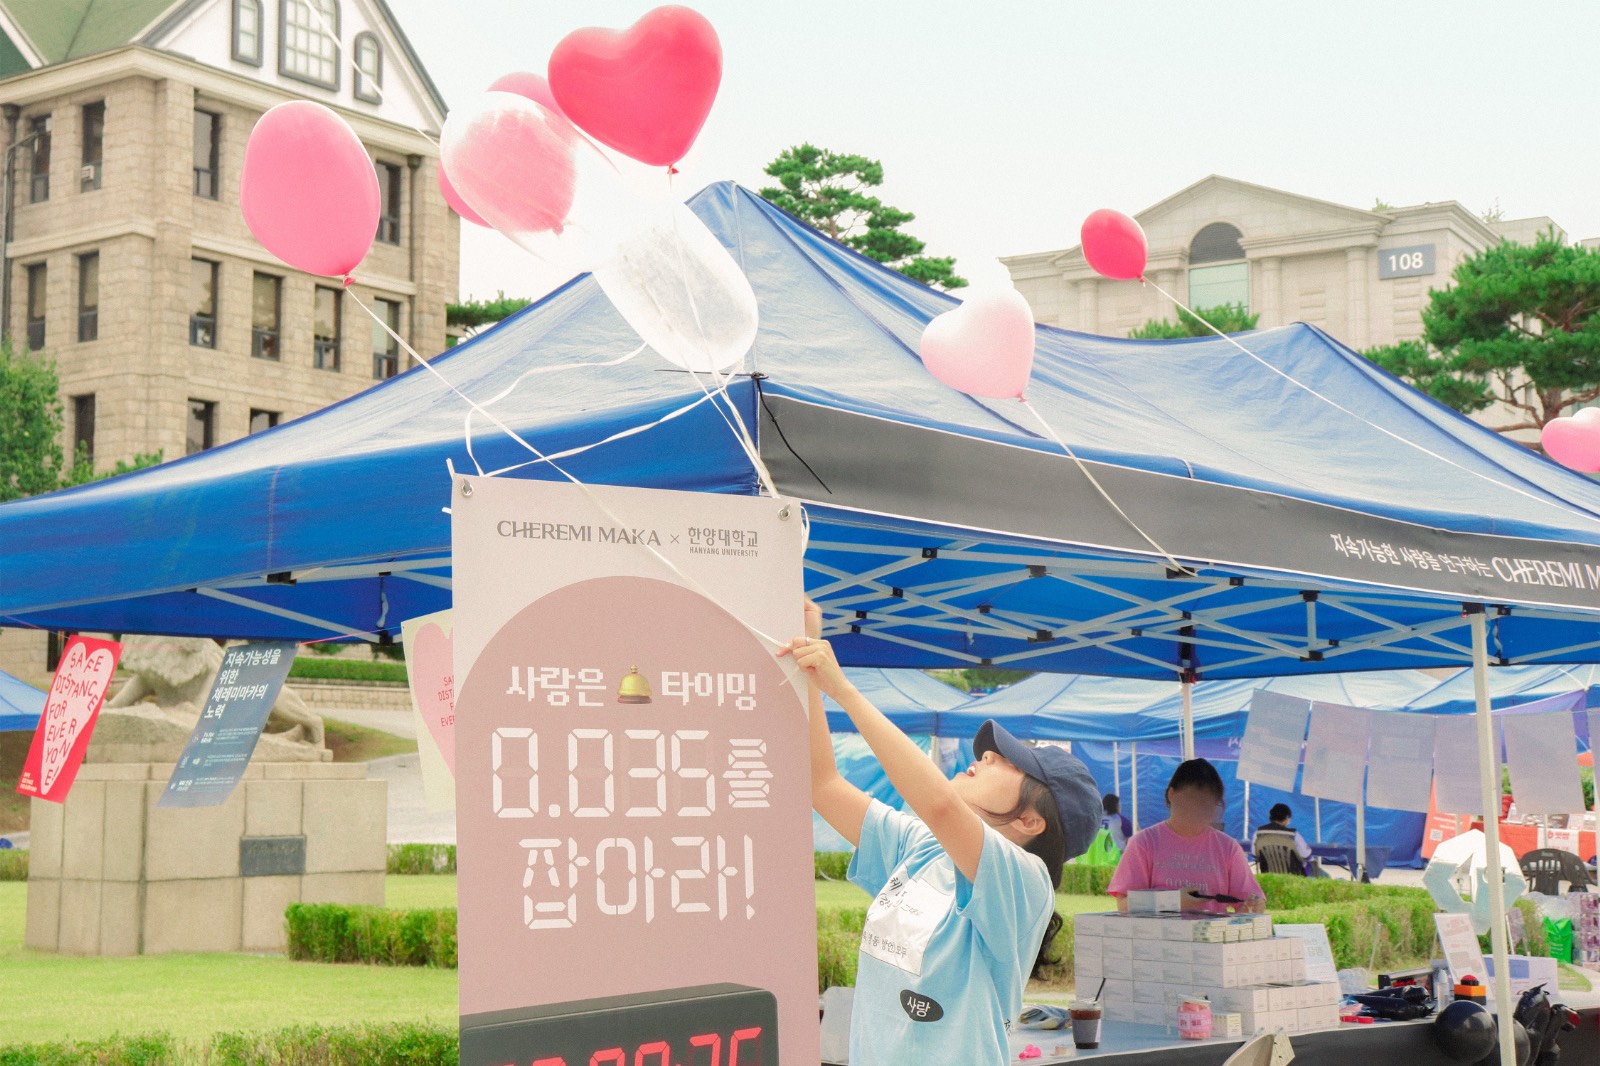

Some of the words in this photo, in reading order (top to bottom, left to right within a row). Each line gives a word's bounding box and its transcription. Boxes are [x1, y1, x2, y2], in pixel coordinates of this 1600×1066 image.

[1388, 252, 1423, 272] 108
[497, 520, 592, 542] CHEREMI
[598, 526, 661, 546] MAKA
[688, 526, 759, 548] 한양대학교
[689, 546, 720, 555] HANYANG
[721, 548, 759, 557] UNIVERSITY
[1330, 533, 1401, 566] 지속가능한
[1399, 546, 1442, 572] 사랑을
[1437, 553, 1494, 578] 연구하는
[1491, 556, 1586, 589] CHEREMI
[70, 652, 104, 673] SAFE
[225, 648, 282, 668] 지속가능성을
[219, 668, 240, 685] 위한
[443, 675, 454, 687] SA
[55, 673, 99, 713] DISTANCE
[437, 688, 454, 702] DIST
[506, 665, 607, 707] 사랑은
[661, 671, 757, 711] 타이밍
[48, 699, 68, 721] FOR
[203, 703, 226, 719] 노력
[518, 834, 755, 930] 잡아라!
[907, 996, 931, 1018] 사랑
